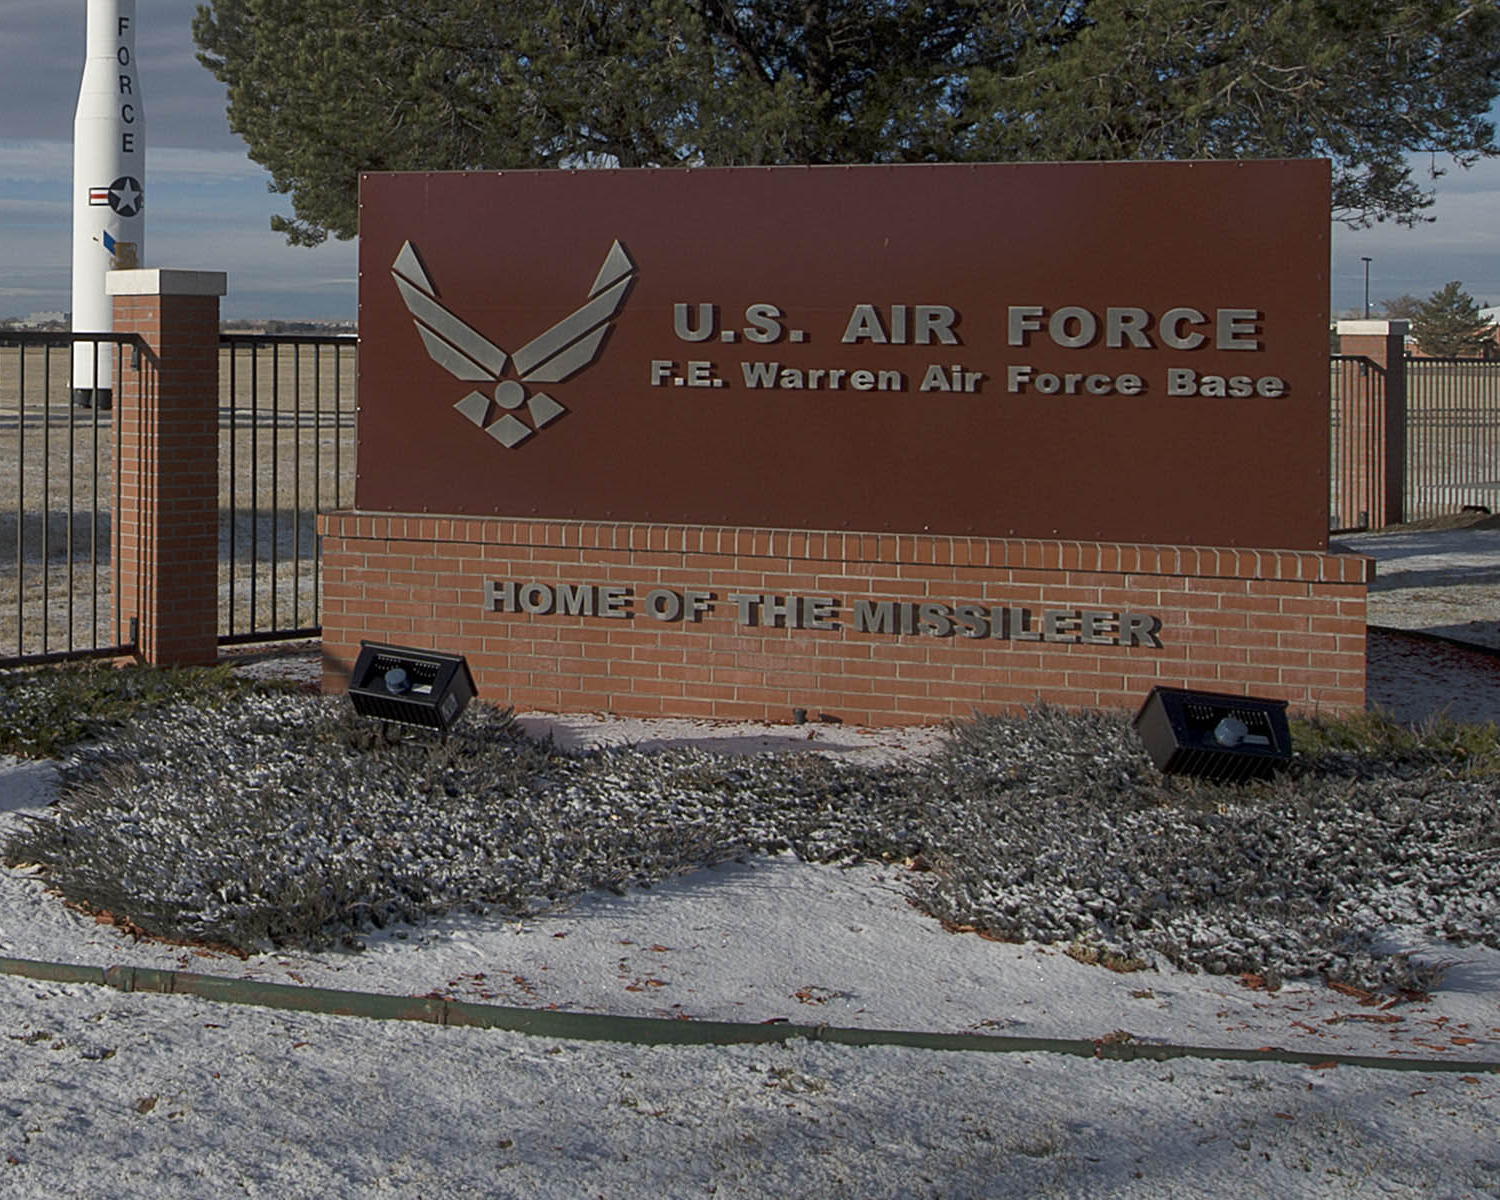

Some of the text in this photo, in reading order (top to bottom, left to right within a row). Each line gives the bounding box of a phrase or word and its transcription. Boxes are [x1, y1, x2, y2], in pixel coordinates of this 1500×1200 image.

[117, 17, 135, 154] FORCE
[673, 302, 1260, 351] U.S. AIR FORCE
[651, 360, 1285, 399] F.E. Warren Air Force Base
[483, 581, 1161, 649] HOME OF THE MISSILEER
